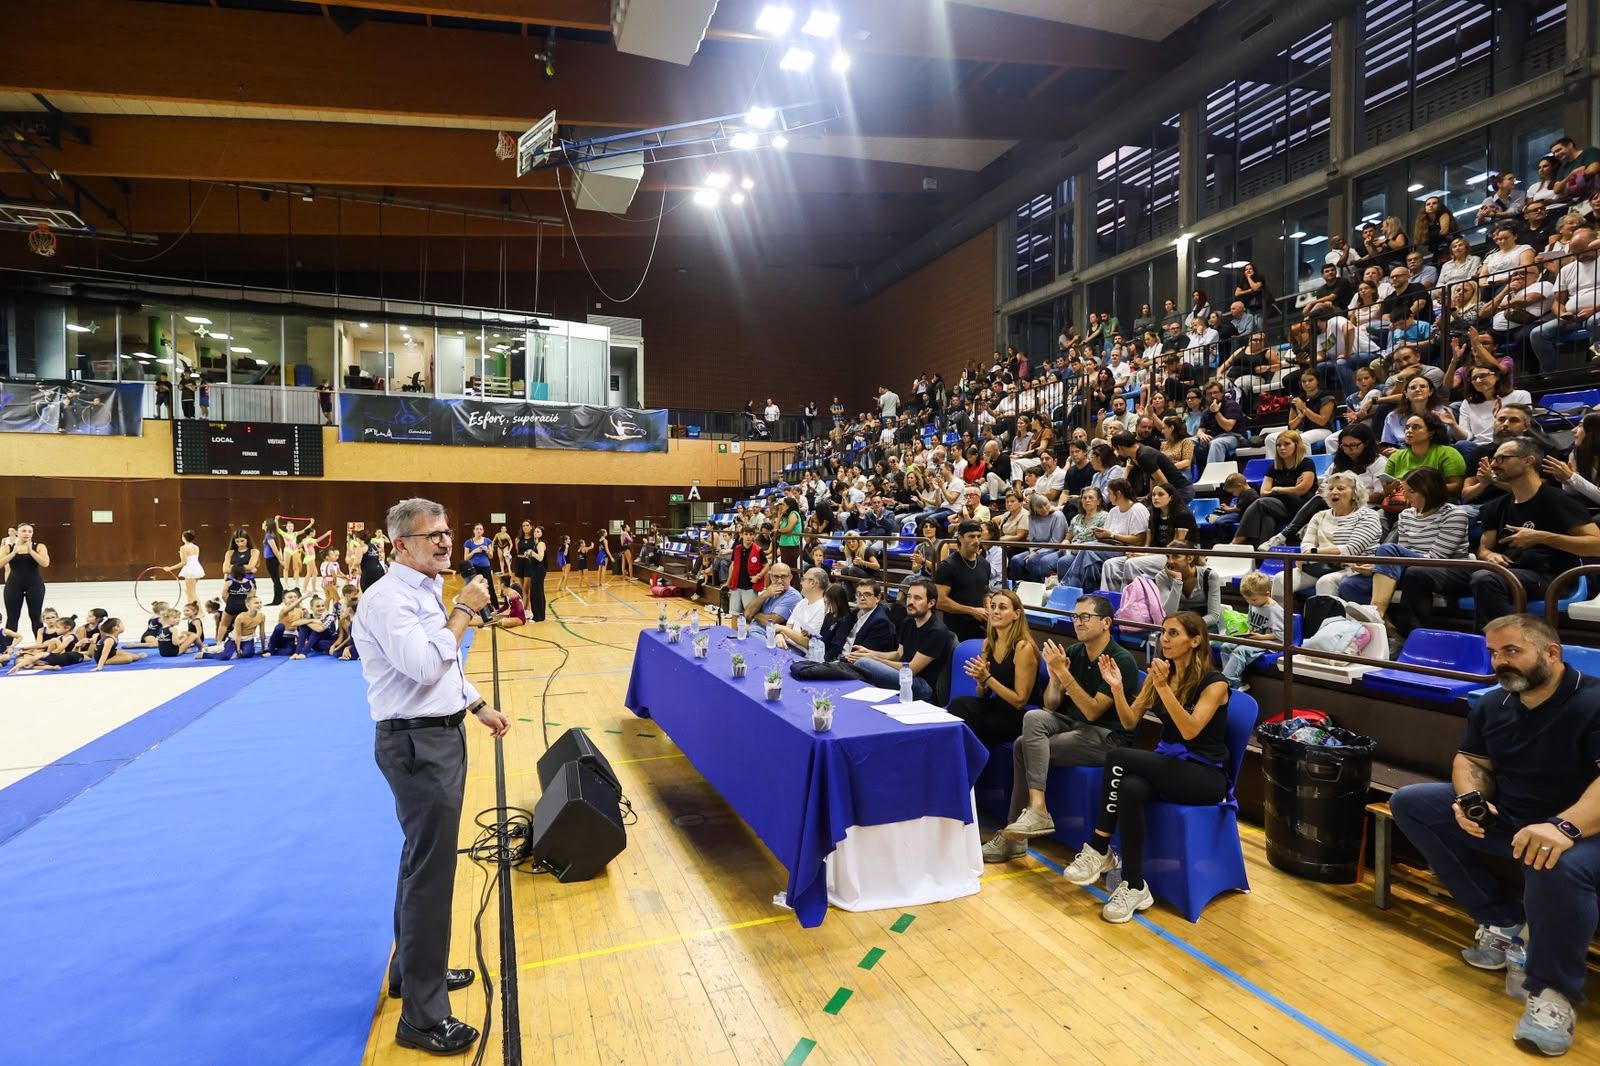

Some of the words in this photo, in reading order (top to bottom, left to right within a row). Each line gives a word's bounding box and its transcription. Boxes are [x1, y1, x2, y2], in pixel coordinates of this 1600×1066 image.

[468, 411, 510, 430] Esforç,
[512, 413, 560, 427] superació
[687, 485, 702, 500] A
